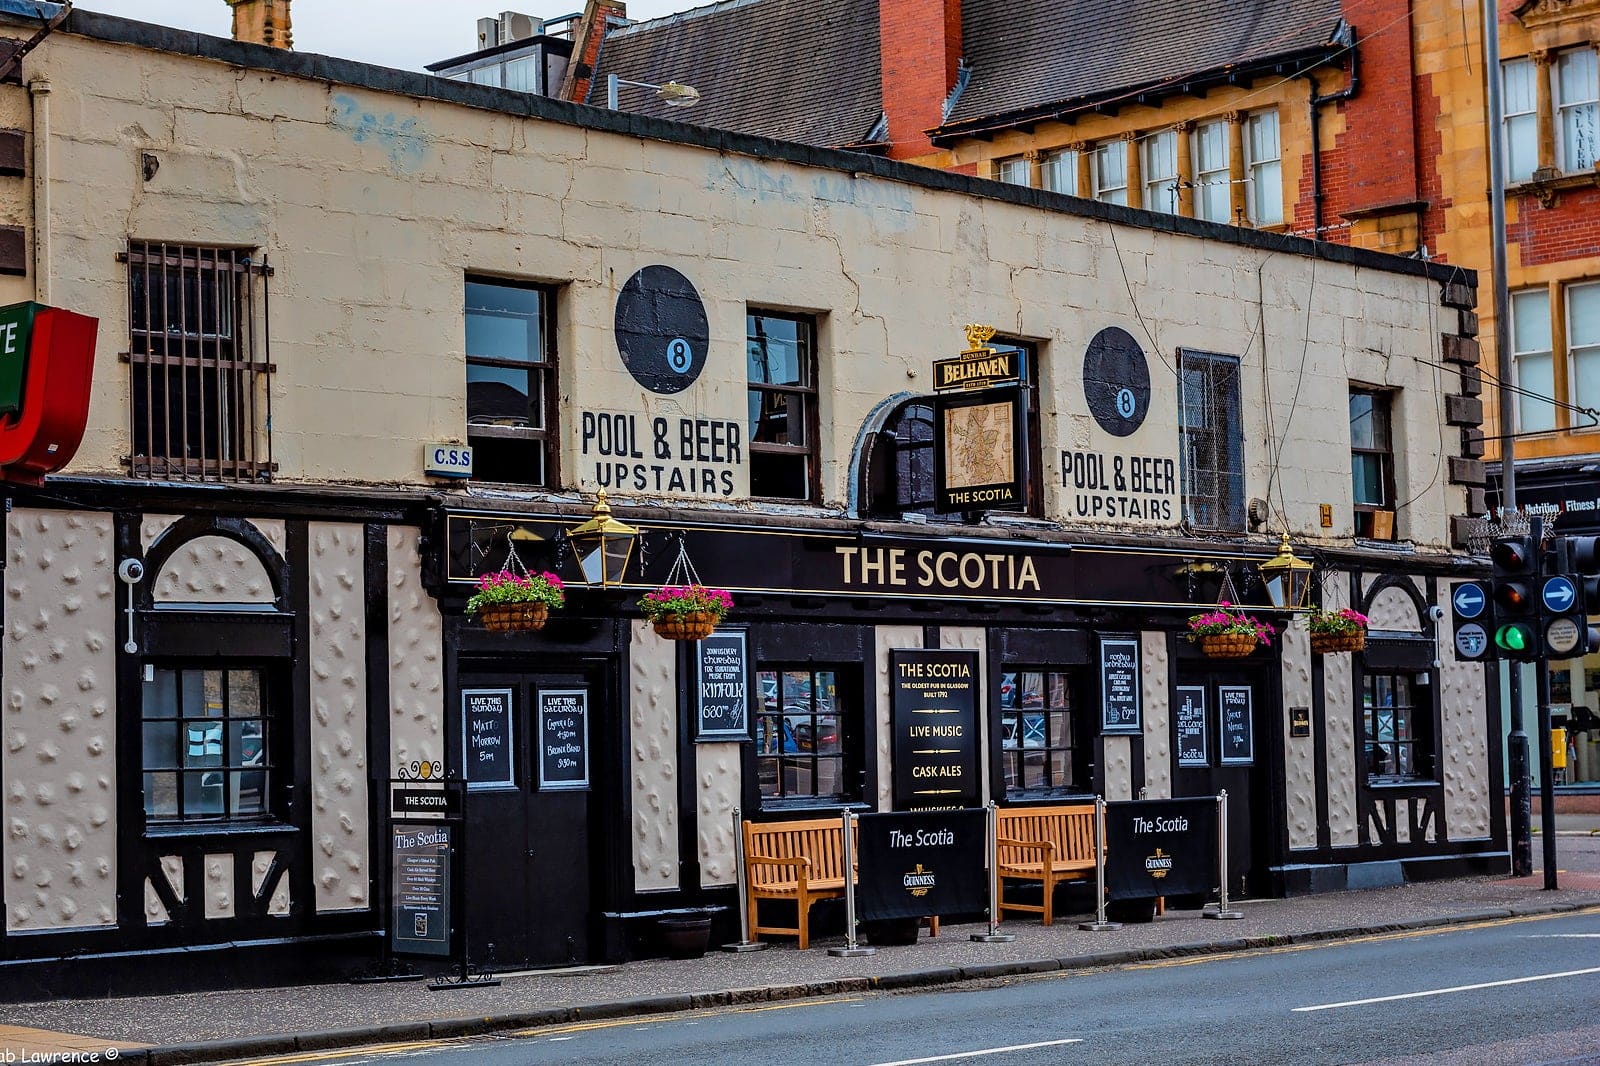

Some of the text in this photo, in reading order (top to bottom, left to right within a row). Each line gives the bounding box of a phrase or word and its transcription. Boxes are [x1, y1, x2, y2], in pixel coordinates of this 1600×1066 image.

[1575, 106, 1585, 169] SLATER
[673, 341, 686, 368] 8
[943, 356, 1010, 385] BELHAVEN
[1121, 391, 1131, 414] 8
[582, 411, 741, 465] POOL & BEER
[434, 448, 470, 467] C.S.S
[595, 462, 734, 497] UPSTAIRS
[1061, 450, 1175, 495] POOL & BEER
[949, 487, 1013, 505] THE SCOTIA
[1076, 494, 1171, 521] UPSTAIRS
[1524, 502, 1560, 516] Nutrition
[1565, 499, 1595, 512] Fitness
[835, 546, 1041, 591] THE SCOTIA
[899, 663, 971, 678] THE SCOTIA
[470, 697, 502, 705] LIVE THIS
[547, 697, 577, 705] LIVE THIS
[937, 690, 948, 698] 1792
[909, 725, 963, 738] LIVE MUSIC
[912, 765, 962, 778] CASK ALES
[405, 796, 448, 806] THE SCOTIA
[1133, 815, 1188, 834] The Scotia
[394, 829, 448, 849] The Scotia
[889, 827, 954, 848] The Scotia
[1145, 858, 1172, 869] GUINNESS
[903, 874, 936, 887] GUINNESS
